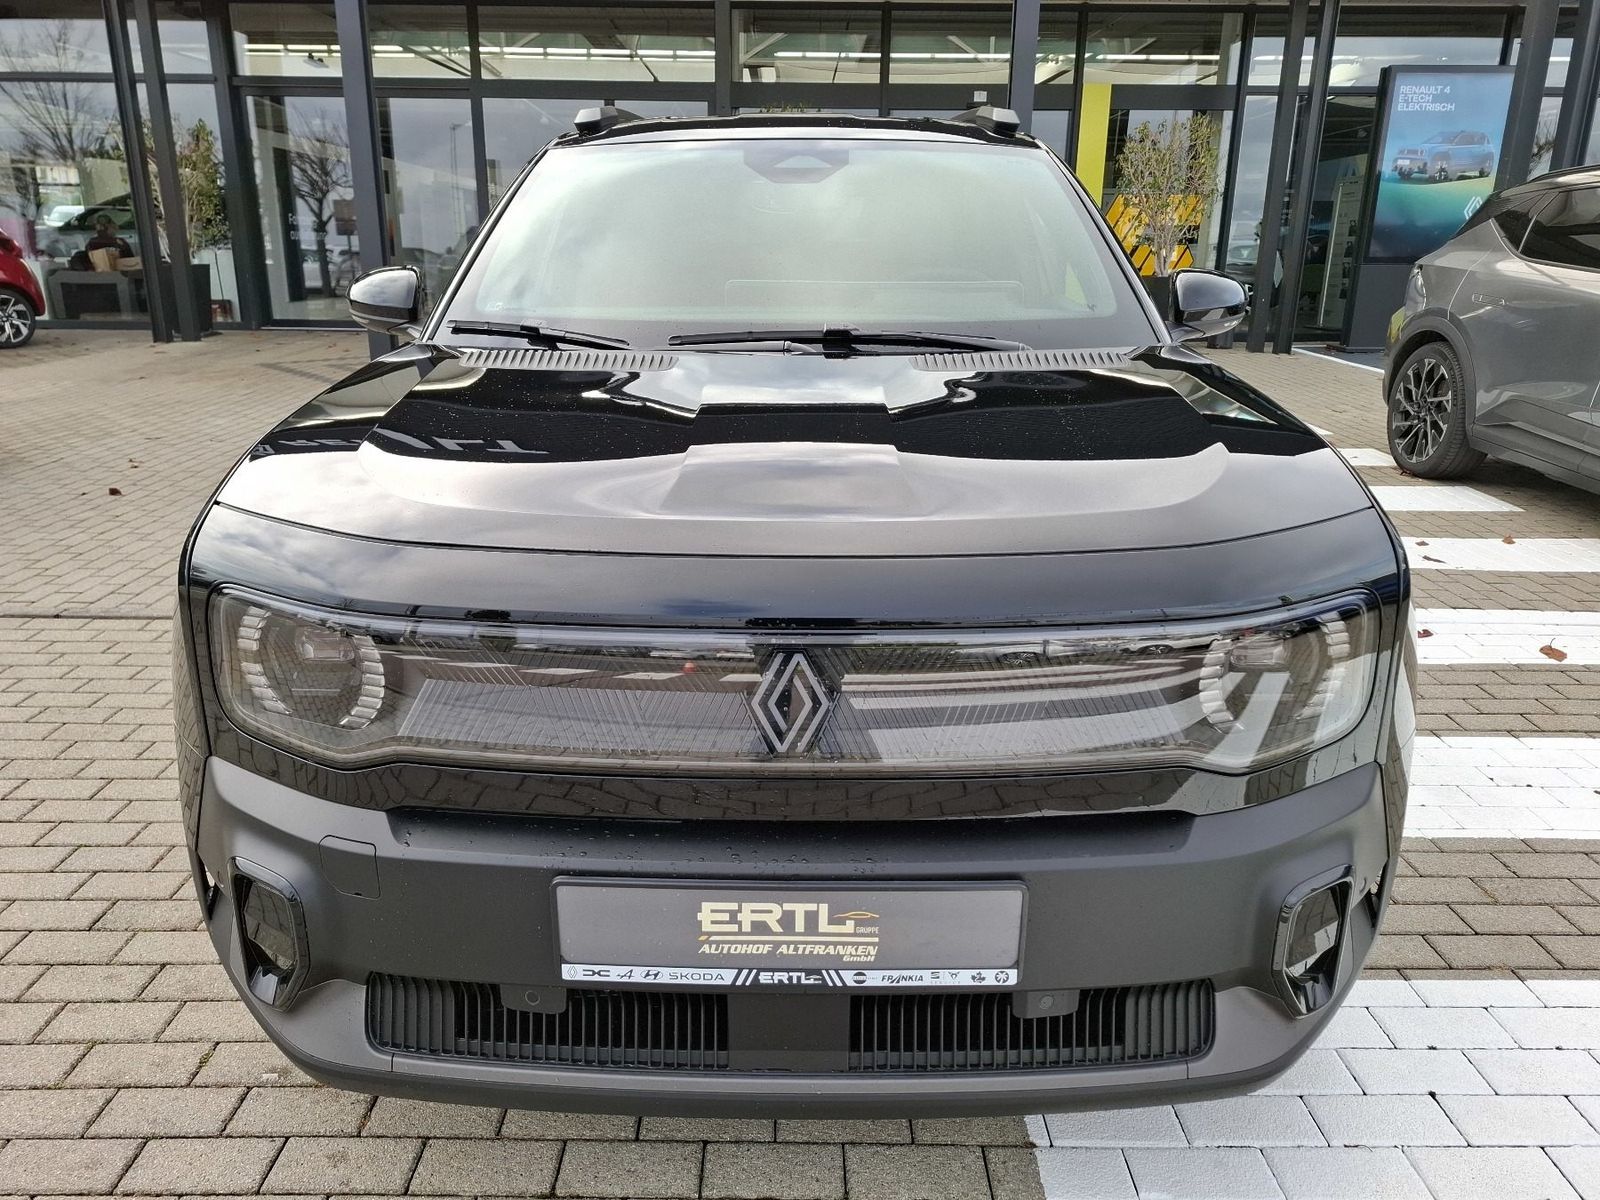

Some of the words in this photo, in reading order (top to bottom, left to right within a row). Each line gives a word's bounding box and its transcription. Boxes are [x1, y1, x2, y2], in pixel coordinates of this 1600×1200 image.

[1400, 85, 1443, 94] RENAULT
[1444, 85, 1451, 94] 4
[1399, 94, 1433, 102] E-TECH
[1398, 103, 1455, 111] ELEKTRISCH
[697, 902, 855, 933] ERTL
[855, 926, 880, 934] GRUPPE
[698, 944, 773, 954] AUTOHOF
[776, 944, 878, 956] ALTFRANKEN
[758, 972, 814, 984] ERTL
[881, 974, 924, 984] FRANKIA
